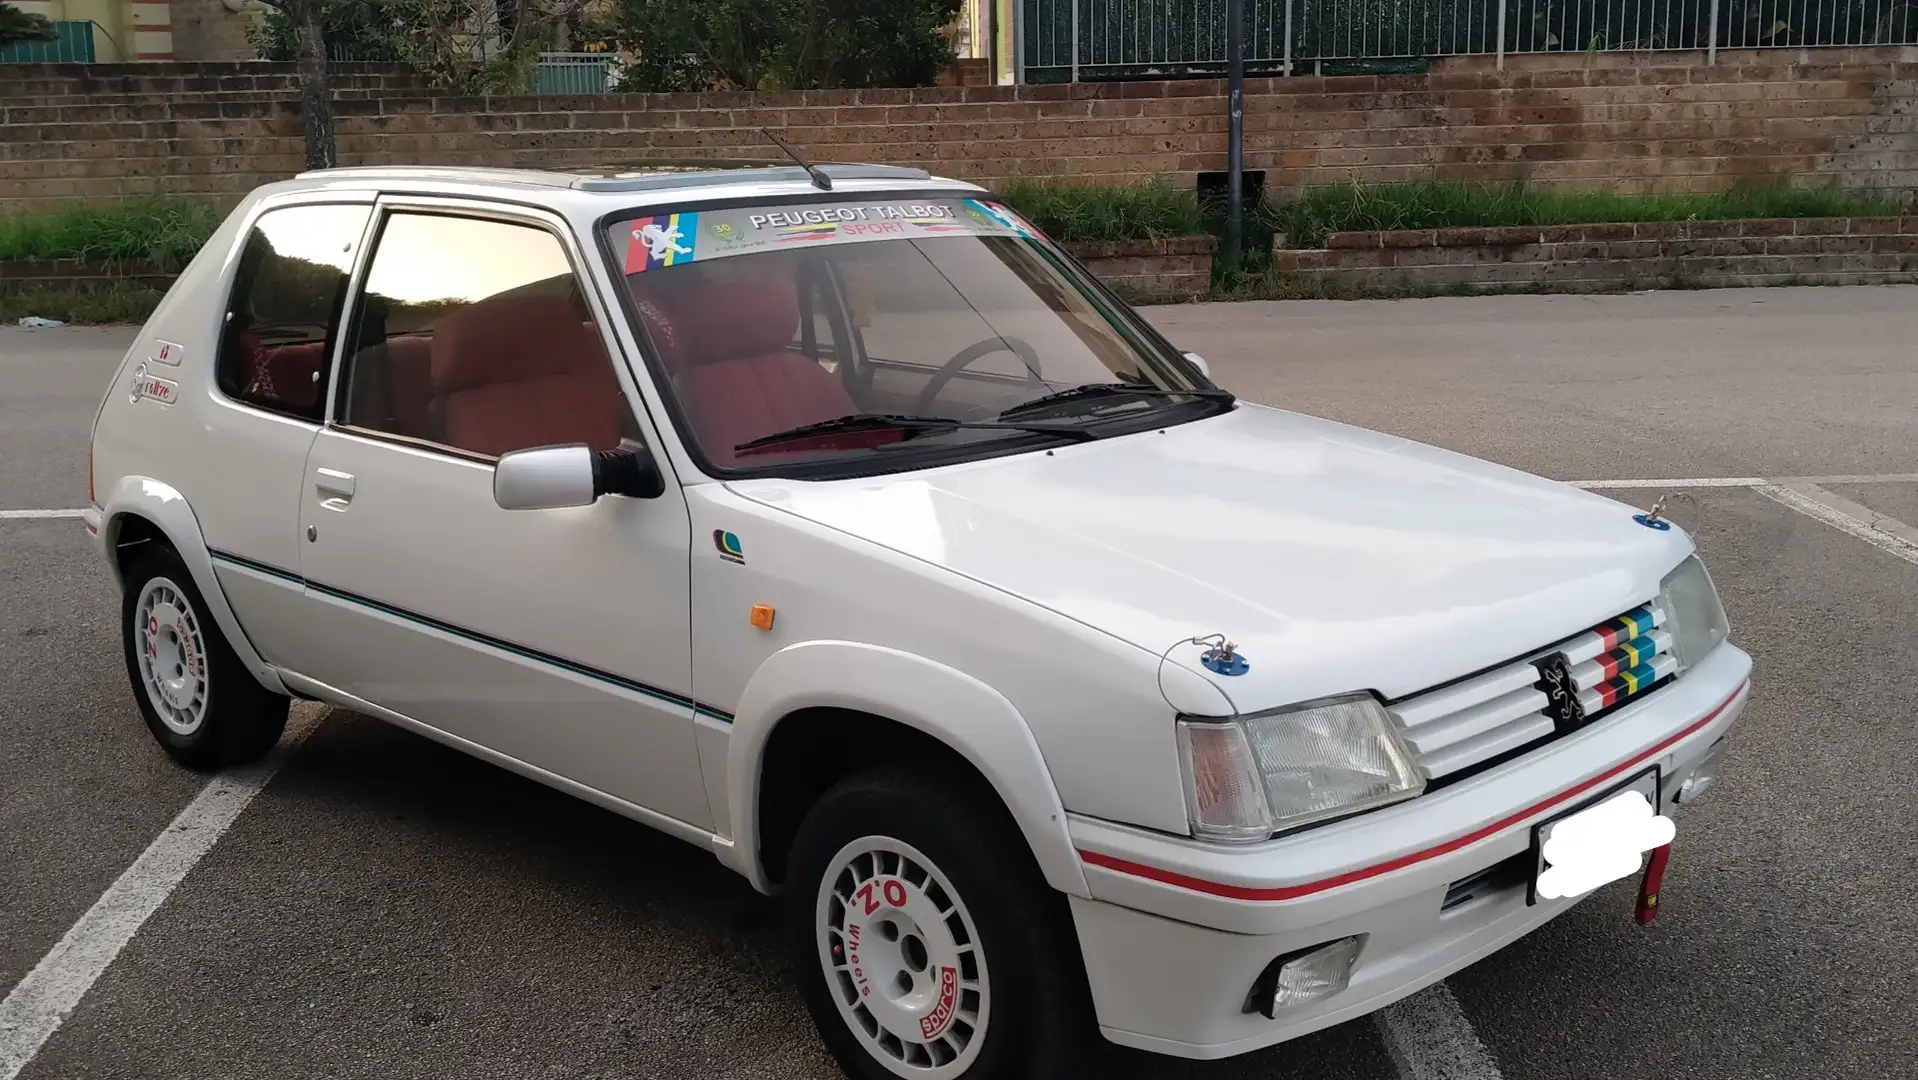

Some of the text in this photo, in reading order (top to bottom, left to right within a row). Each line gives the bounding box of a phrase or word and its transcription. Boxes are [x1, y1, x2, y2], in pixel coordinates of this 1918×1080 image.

[750, 206, 871, 230] PEUGEOT
[871, 204, 957, 219] TALBOT
[843, 221, 906, 236] SPORT
[922, 970, 954, 1034] sparco
